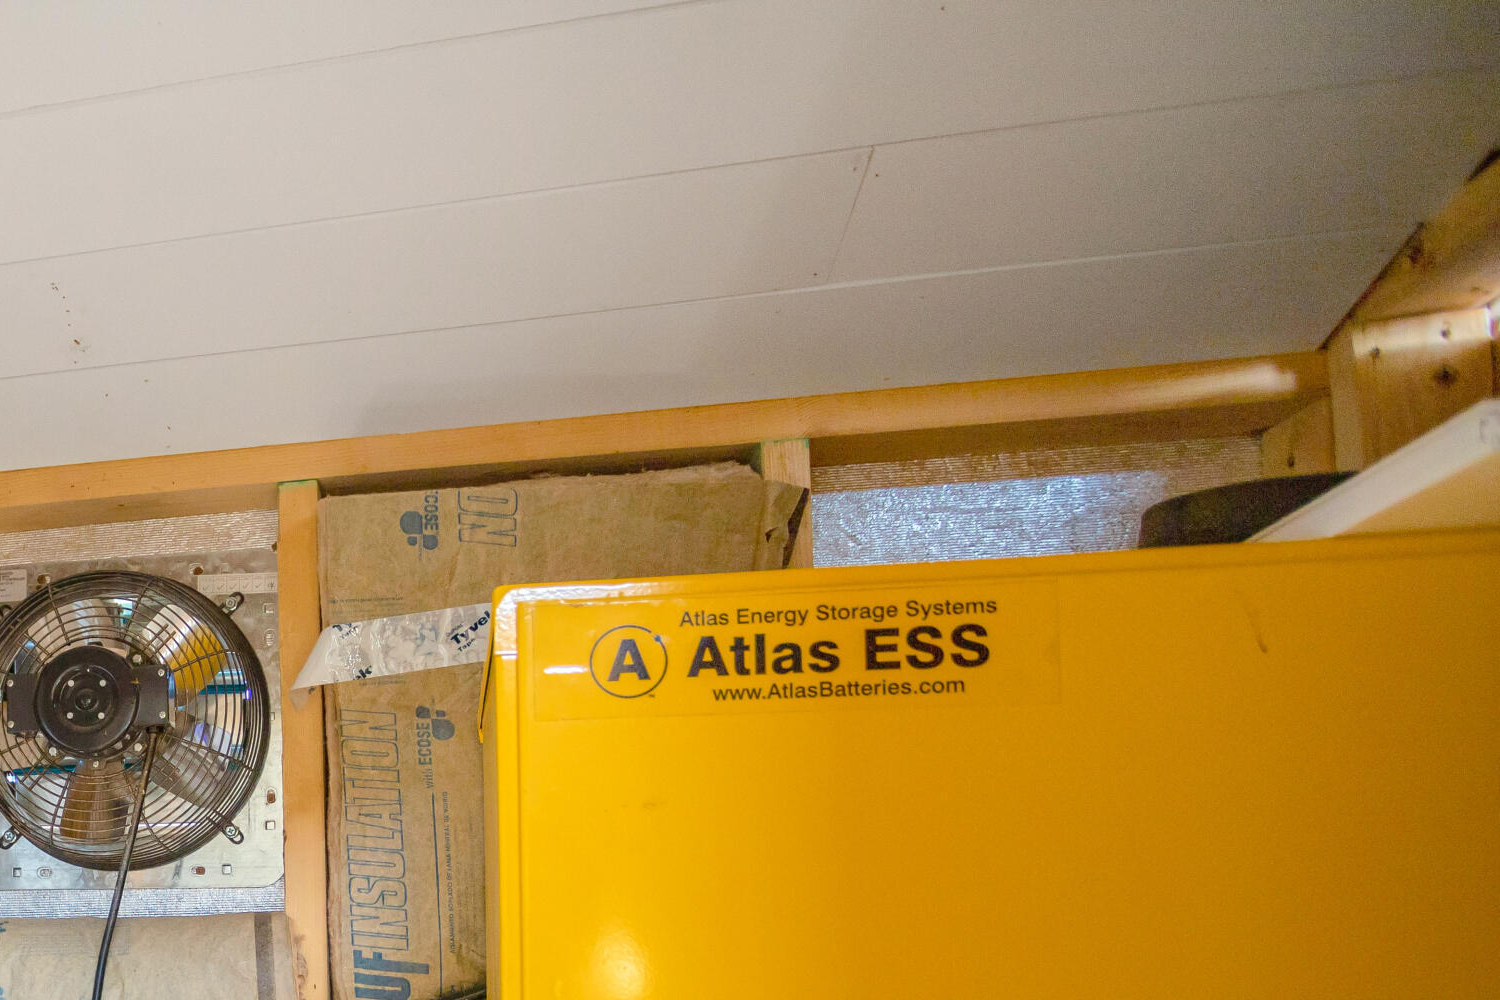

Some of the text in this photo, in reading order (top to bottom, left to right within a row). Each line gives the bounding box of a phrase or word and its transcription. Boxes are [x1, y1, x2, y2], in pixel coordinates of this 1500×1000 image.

[423, 490, 439, 533] COSE
[680, 599, 998, 628] Atlas Energy Storage Systems
[687, 623, 991, 678] Atlas ESS
[713, 678, 966, 701] www.AtlasBatteries.com
[418, 722, 432, 767] ECOSE
[340, 709, 409, 952] INSULATION
